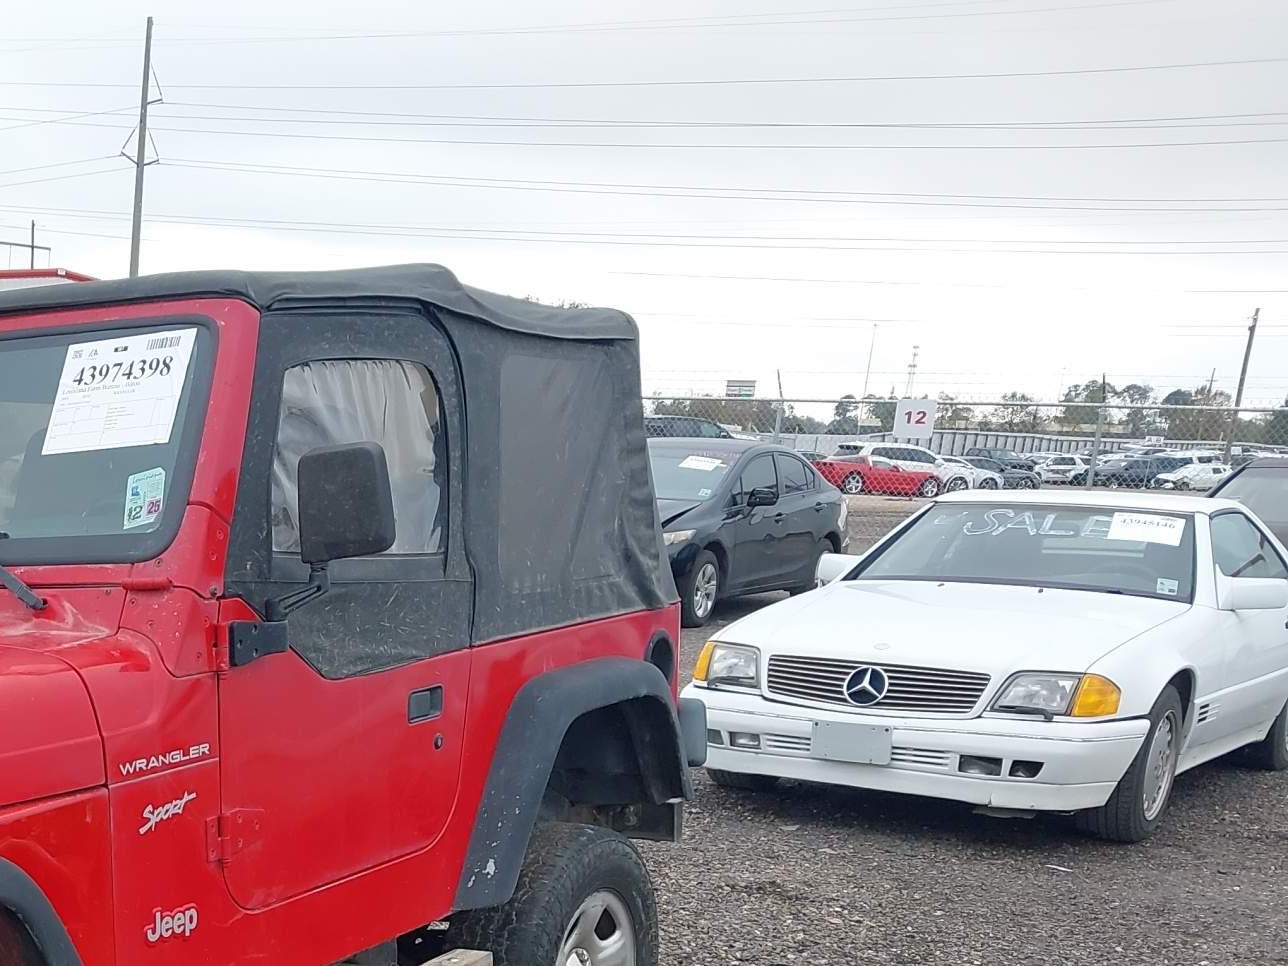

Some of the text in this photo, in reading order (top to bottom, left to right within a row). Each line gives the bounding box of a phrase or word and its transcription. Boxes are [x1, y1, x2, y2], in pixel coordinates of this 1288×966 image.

[73, 356, 174, 387] 43974398
[904, 410, 927, 425] 12
[147, 500, 161, 514] 25
[963, 509, 1112, 537] SALE
[119, 742, 210, 777] WRANGLER
[138, 790, 197, 835] Sport
[145, 906, 198, 943] Jeep
